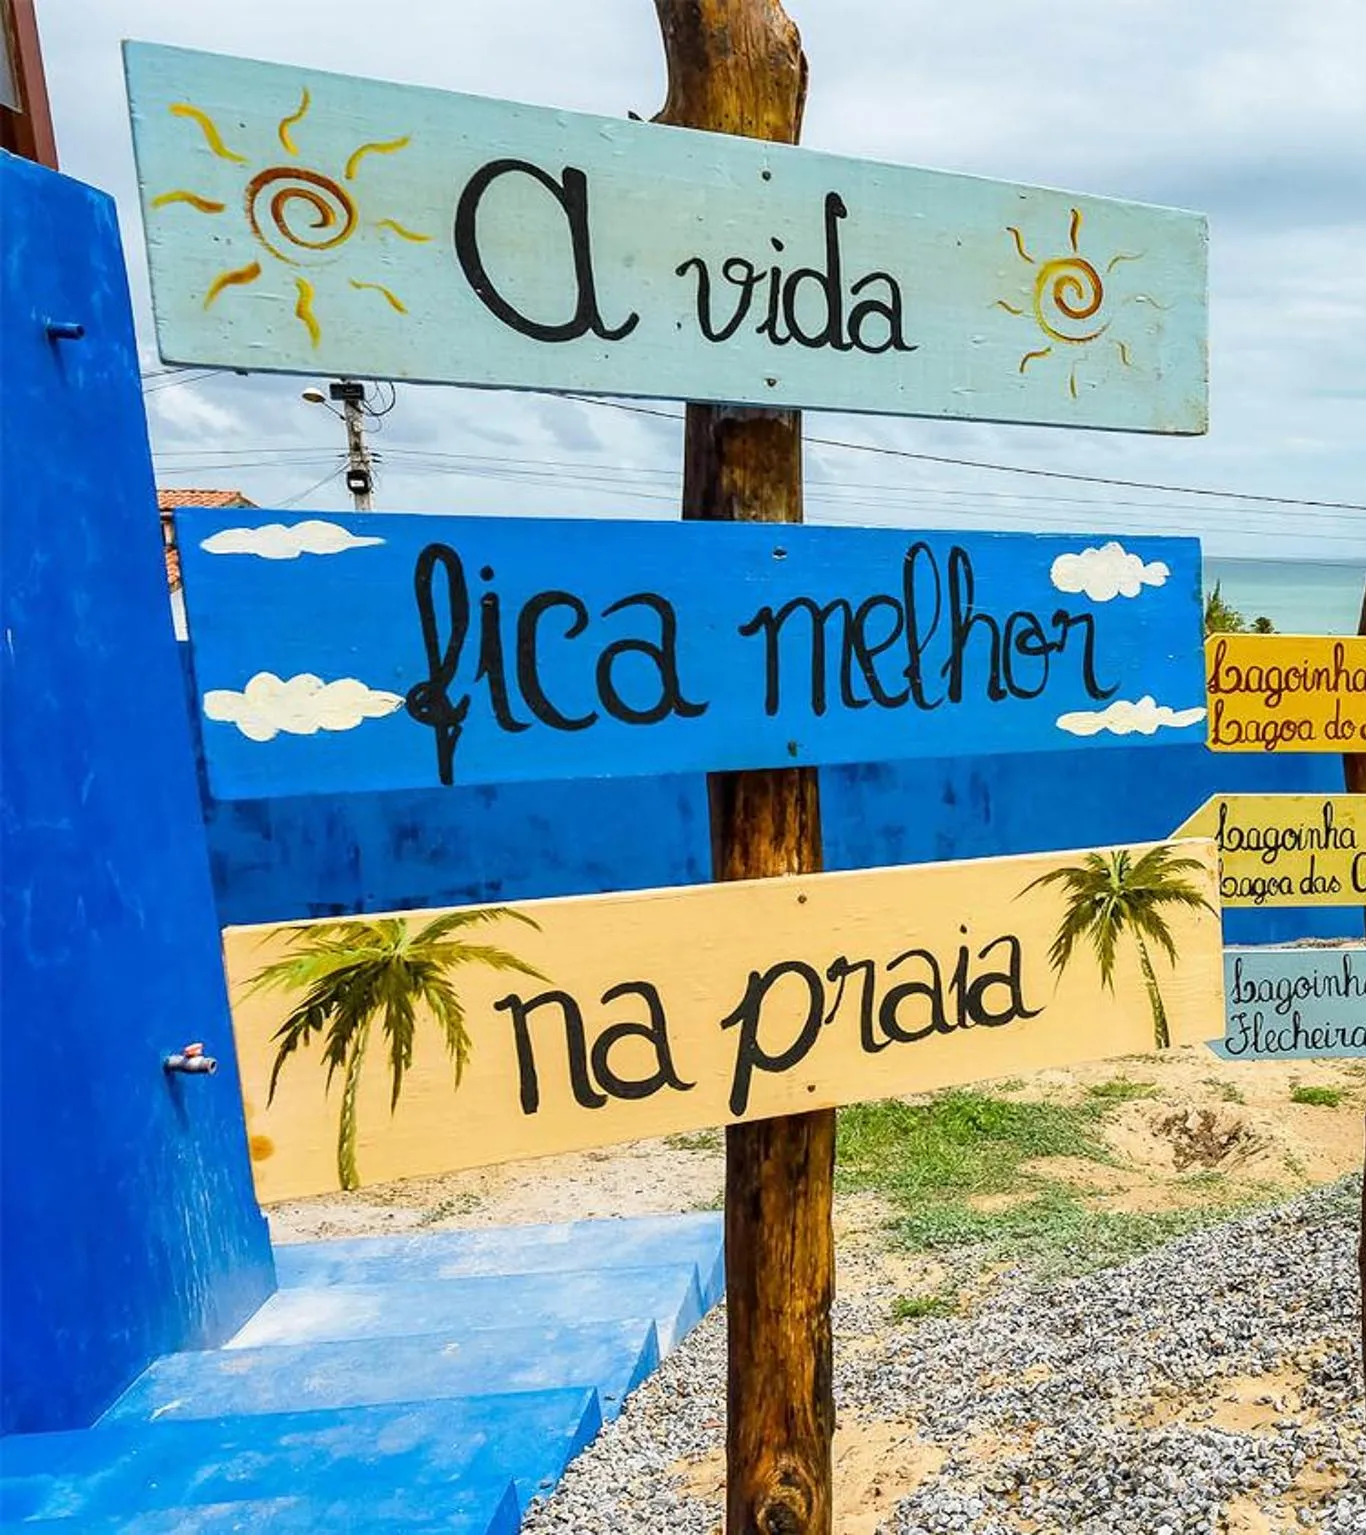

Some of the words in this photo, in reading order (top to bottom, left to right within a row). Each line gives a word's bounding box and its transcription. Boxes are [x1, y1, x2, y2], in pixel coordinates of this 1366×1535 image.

[674, 190, 918, 354] vida
[404, 541, 709, 786] fica
[740, 540, 1120, 717] melhor
[1210, 699, 1313, 751] Lagoa
[1324, 698, 1358, 741] do
[1214, 801, 1358, 865] Lagoinha
[1299, 855, 1342, 895] das
[494, 980, 694, 1115] na
[720, 923, 1044, 1116] praia
